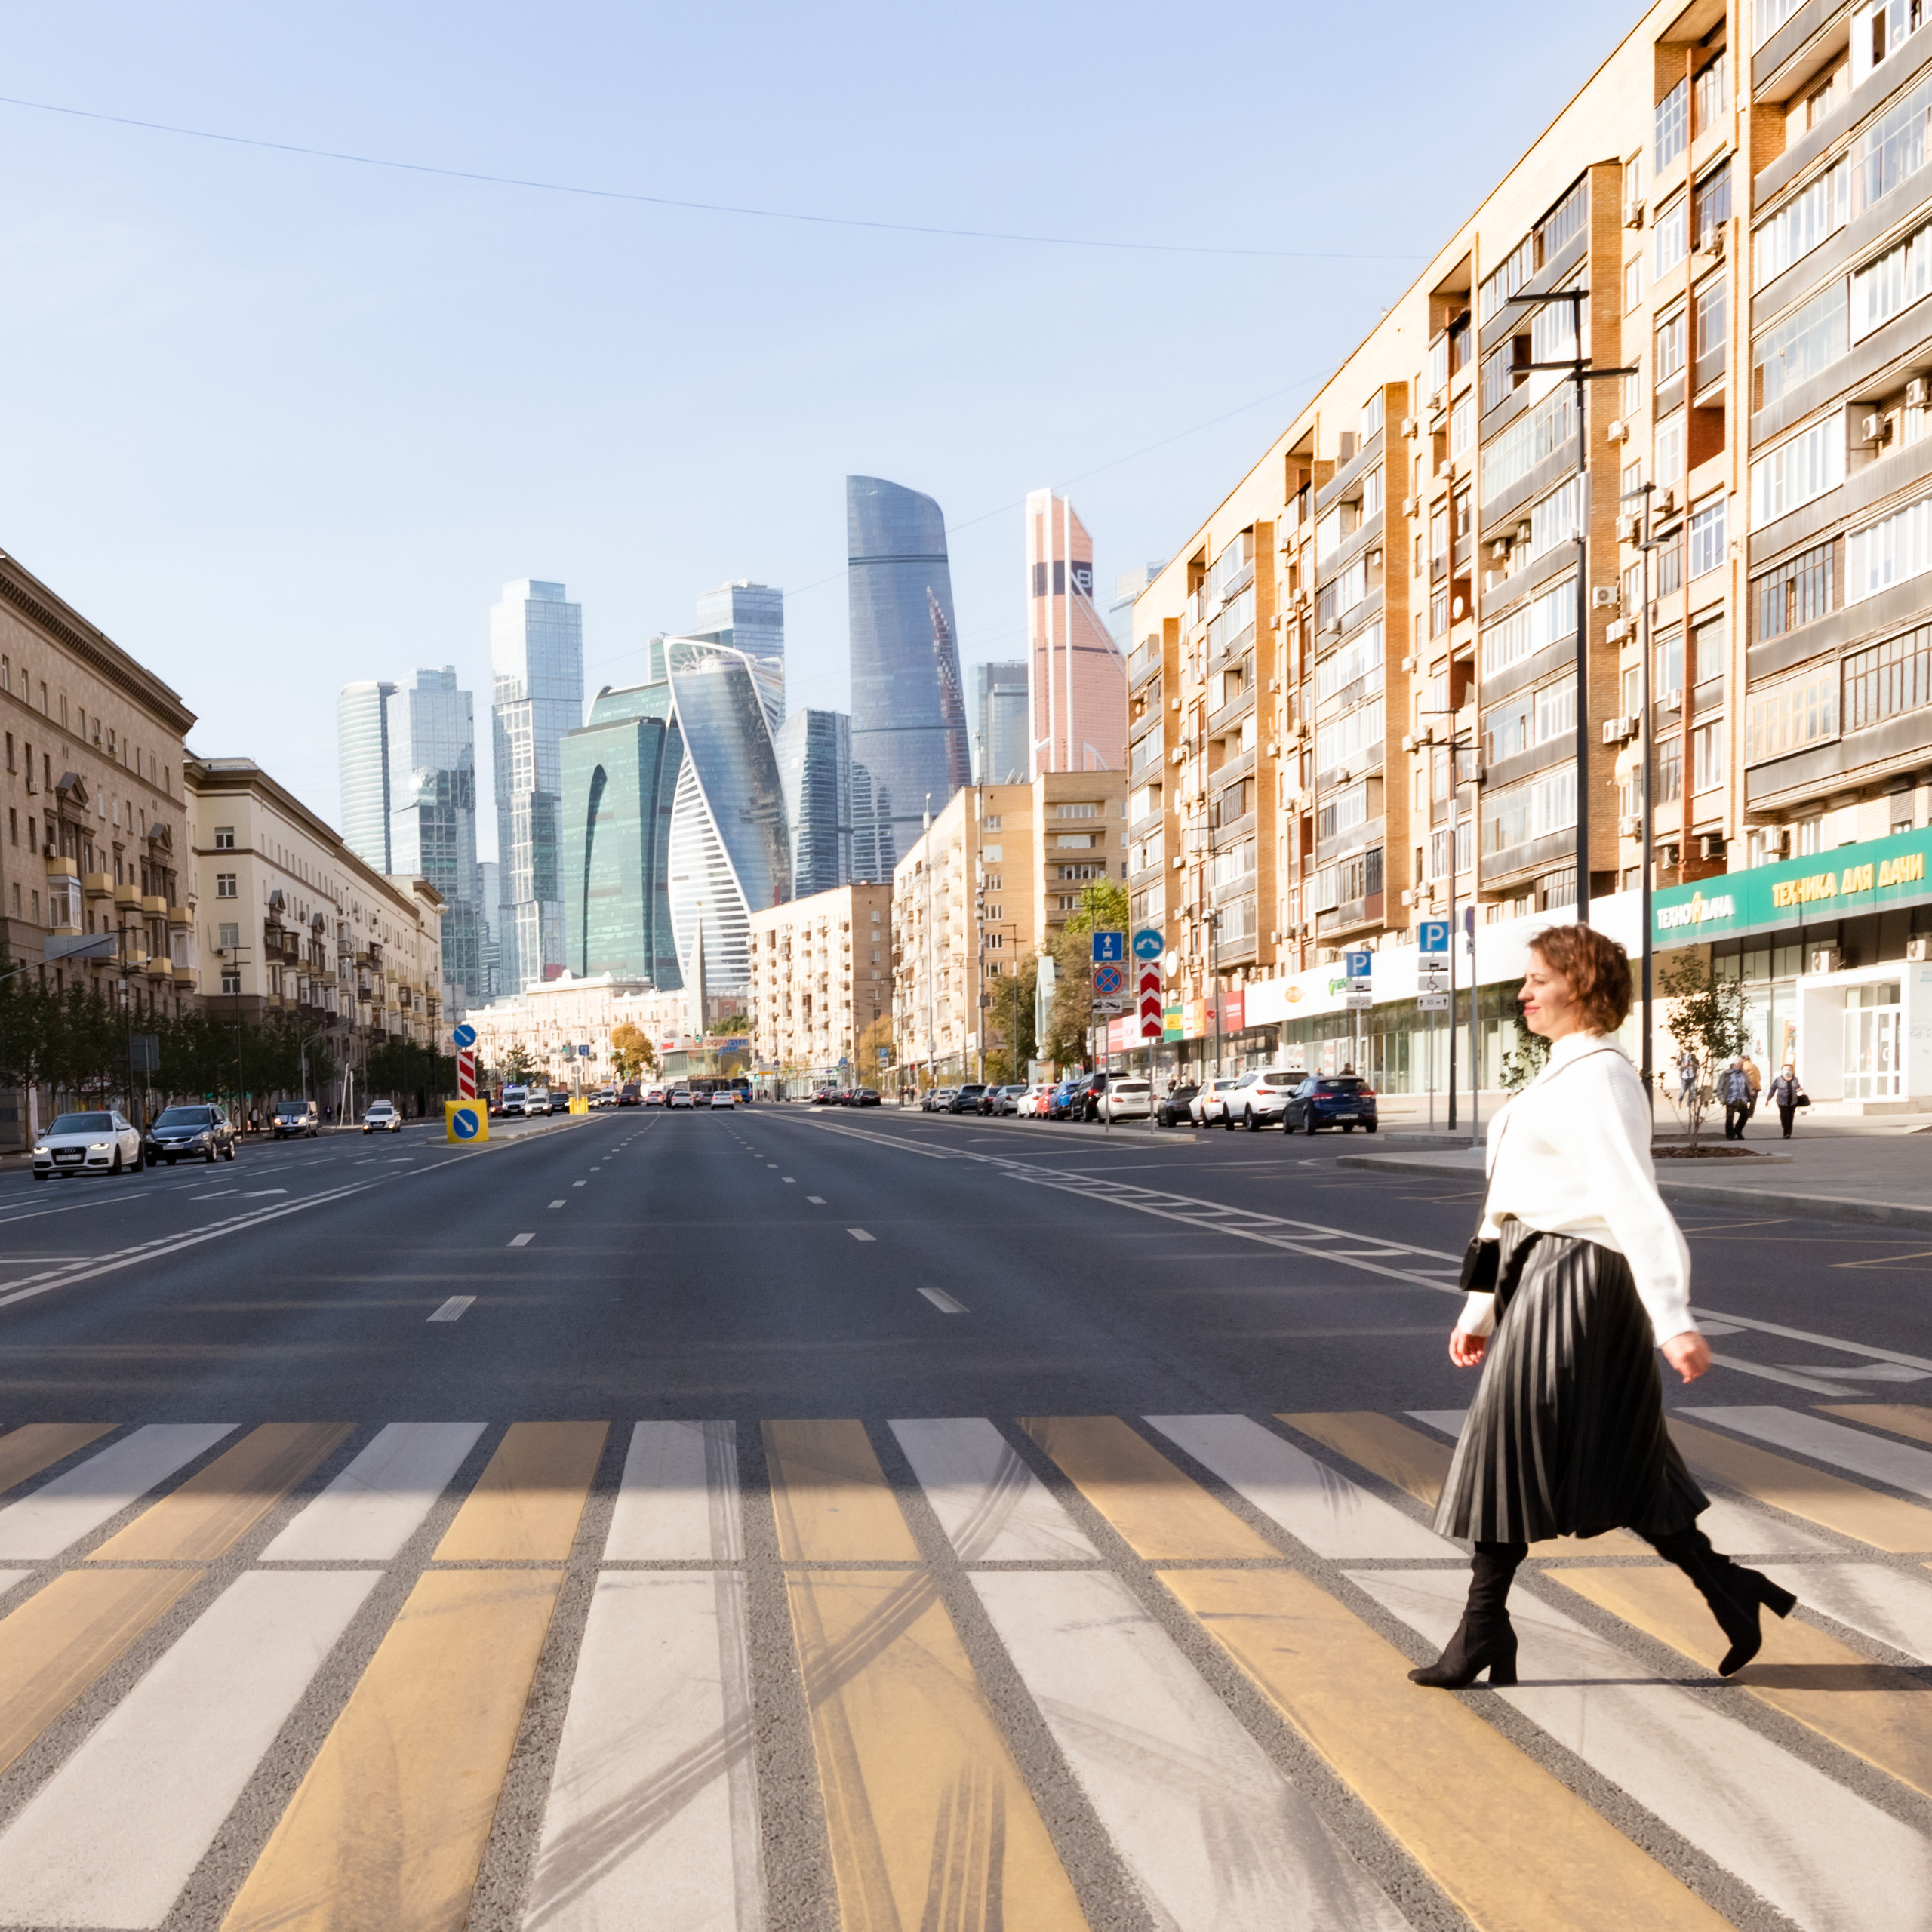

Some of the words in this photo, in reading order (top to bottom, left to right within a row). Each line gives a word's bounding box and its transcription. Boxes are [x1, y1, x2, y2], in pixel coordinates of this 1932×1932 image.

[1772, 872, 1838, 907] ТЕХНИКА
[1840, 863, 1875, 894] ДЛЯ
[1877, 853, 1925, 887] ДАЧИ
[1426, 925, 1444, 949] P
[1352, 954, 1367, 974] P
